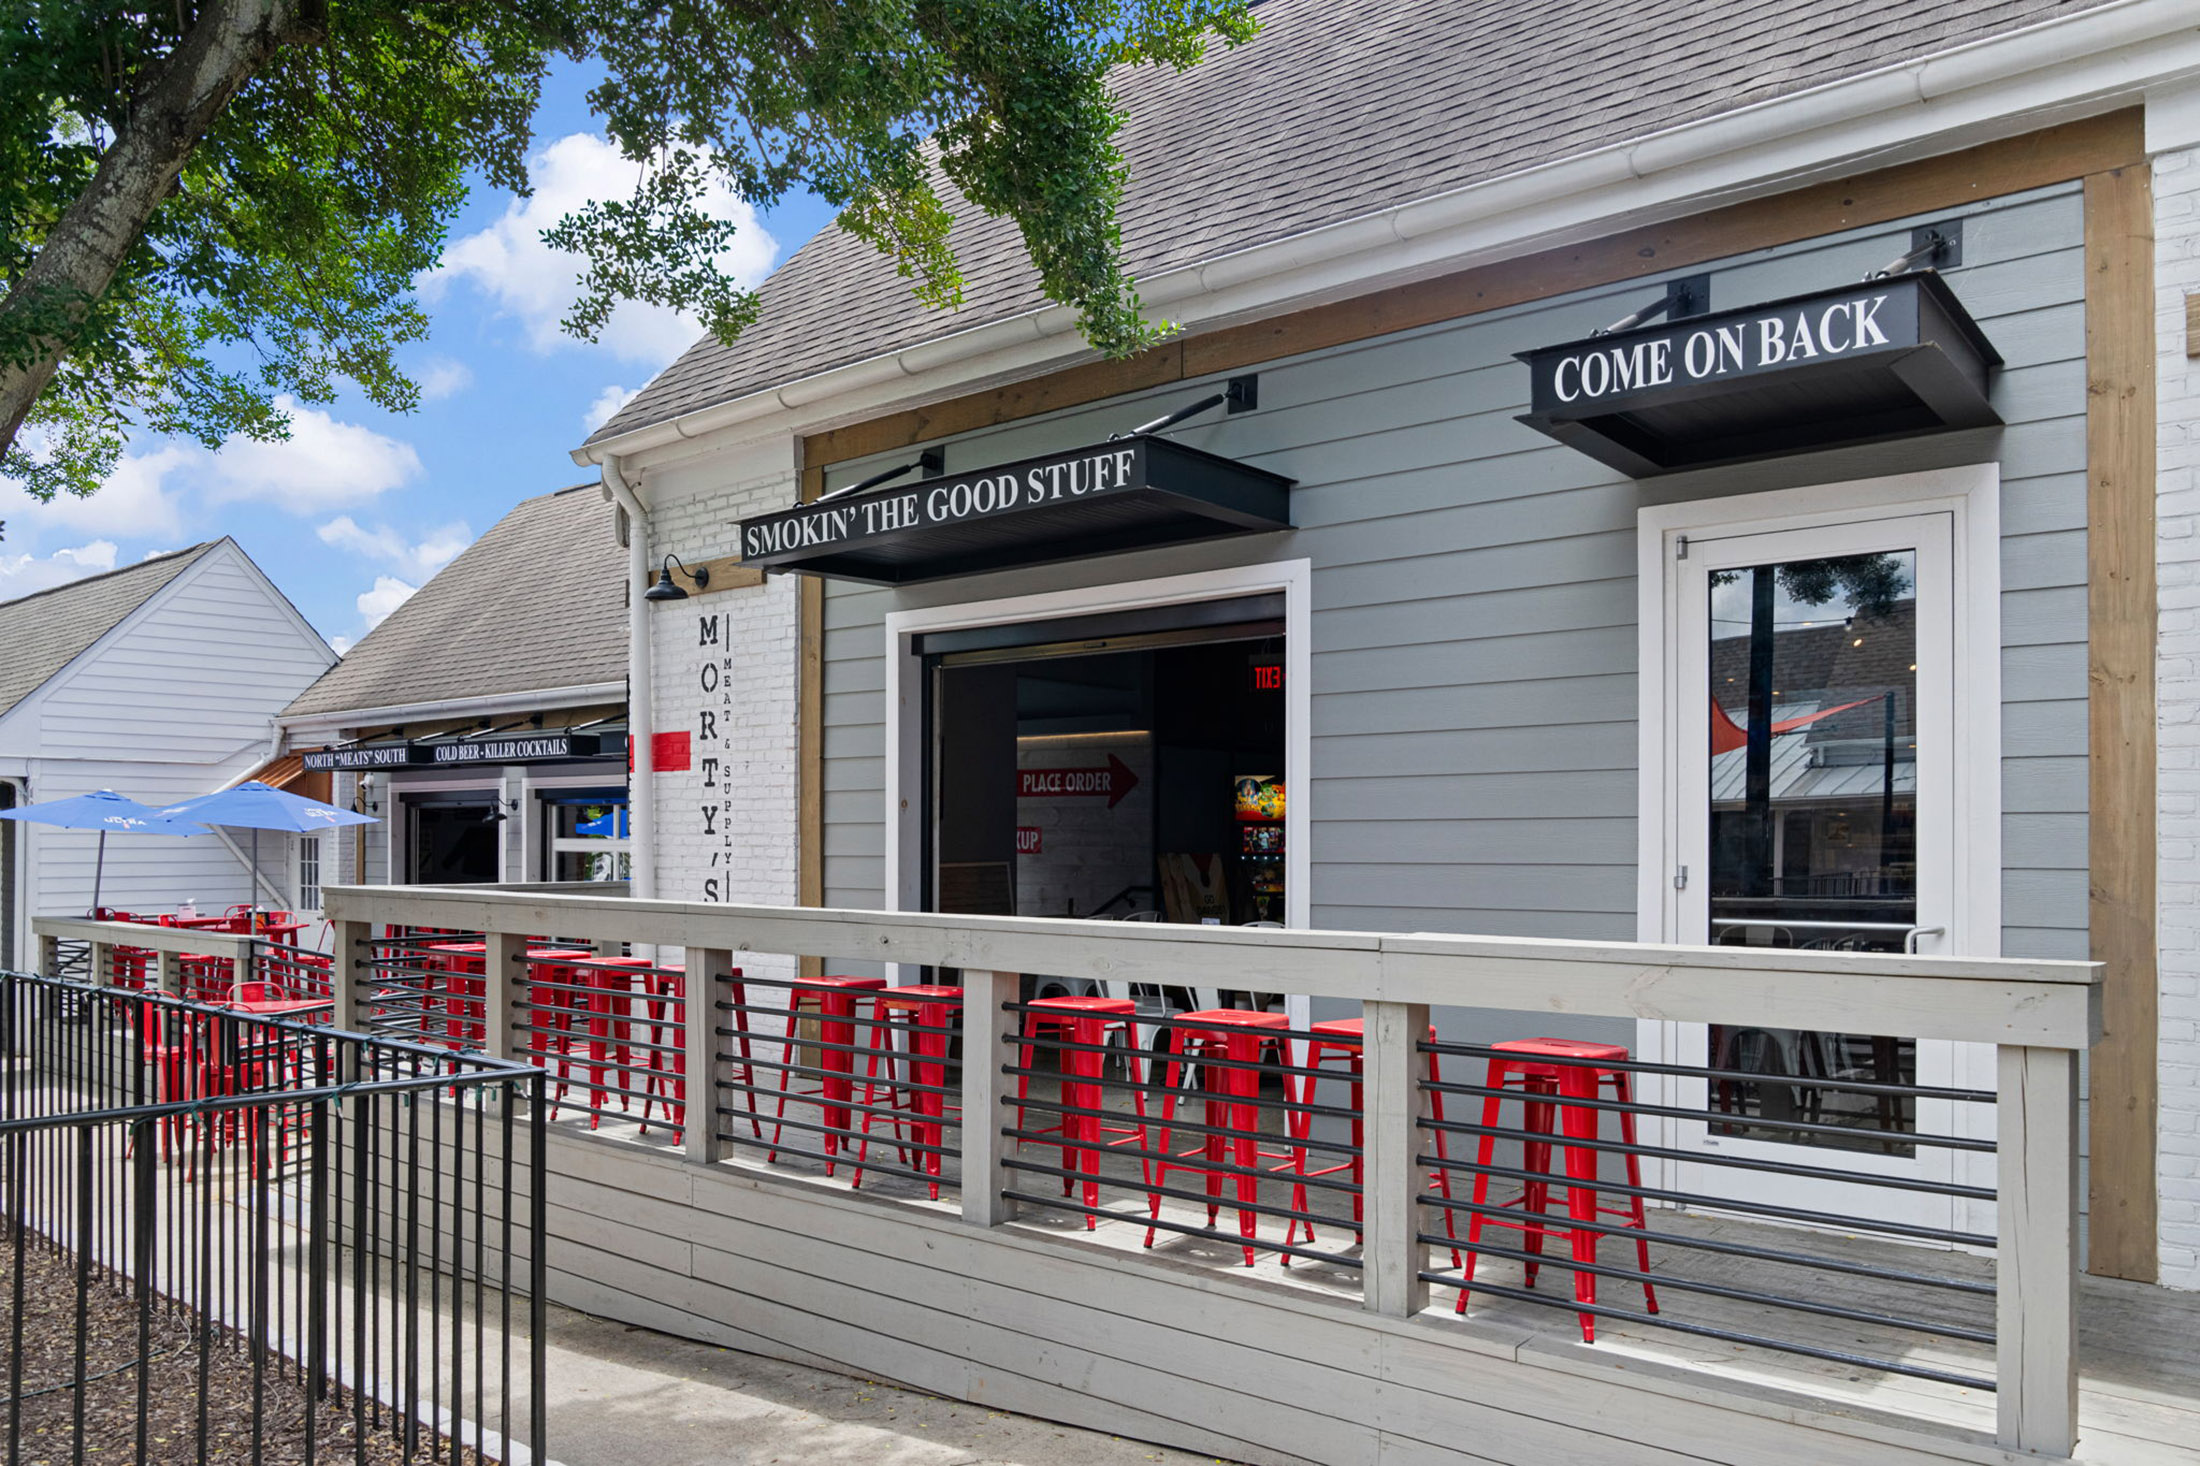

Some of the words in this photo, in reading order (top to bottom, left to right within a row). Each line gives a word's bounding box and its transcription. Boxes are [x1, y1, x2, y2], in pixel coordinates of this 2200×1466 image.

[1554, 338, 1674, 403] COME
[1684, 322, 1746, 379] ON
[1757, 294, 1890, 367] BACK
[746, 505, 857, 558] SMOKIN'
[861, 493, 920, 535] THE
[927, 473, 1019, 522] GOOD
[1027, 448, 1136, 504] STUFF
[723, 658, 732, 721] MEAT
[304, 753, 334, 769] NORTH
[335, 750, 373, 766] "MEATS"
[374, 748, 406, 763] SOUTH
[436, 746, 458, 762] COLD
[459, 744, 480, 760] BEER
[485, 741, 516, 759] KILLER
[516, 738, 568, 757] COCKTAILS
[699, 614, 719, 902] MORTY'S
[724, 738, 731, 749] &
[1023, 773, 1061, 793] PLACE
[1065, 771, 1112, 792] ORDER
[723, 765, 732, 864] SUPPLY
